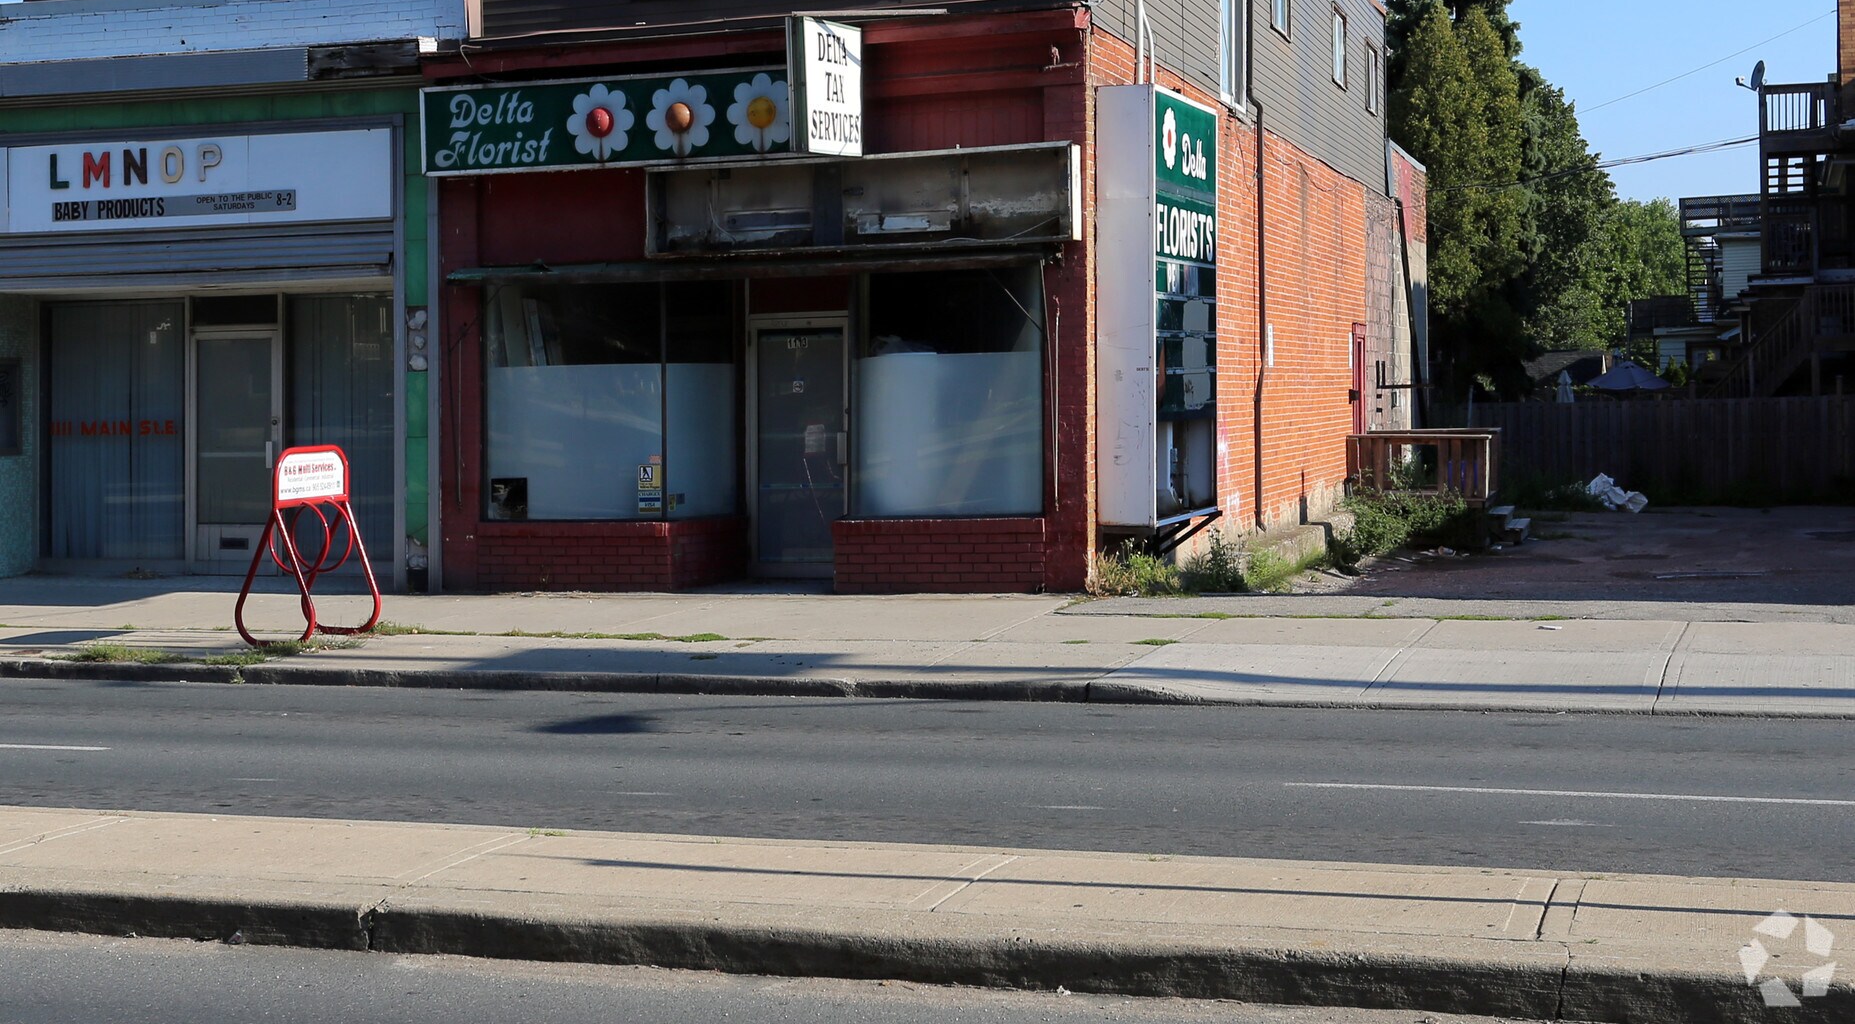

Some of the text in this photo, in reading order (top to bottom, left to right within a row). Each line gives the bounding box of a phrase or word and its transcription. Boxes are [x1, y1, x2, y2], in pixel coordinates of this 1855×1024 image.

[817, 32, 848, 66] DELTA
[825, 71, 845, 104] TAX
[449, 90, 535, 129] Delta
[811, 109, 860, 144] SERVICES
[434, 127, 554, 168] Florist
[1181, 132, 1207, 181] Delta
[54, 197, 165, 222] BABY PRODUCTS
[196, 192, 292, 207] OPEN TO THE PUBLIC 8-2
[213, 202, 255, 211] SATURDAYS
[1156, 203, 1214, 263] FLORISTS
[81, 419, 132, 436] MAIN
